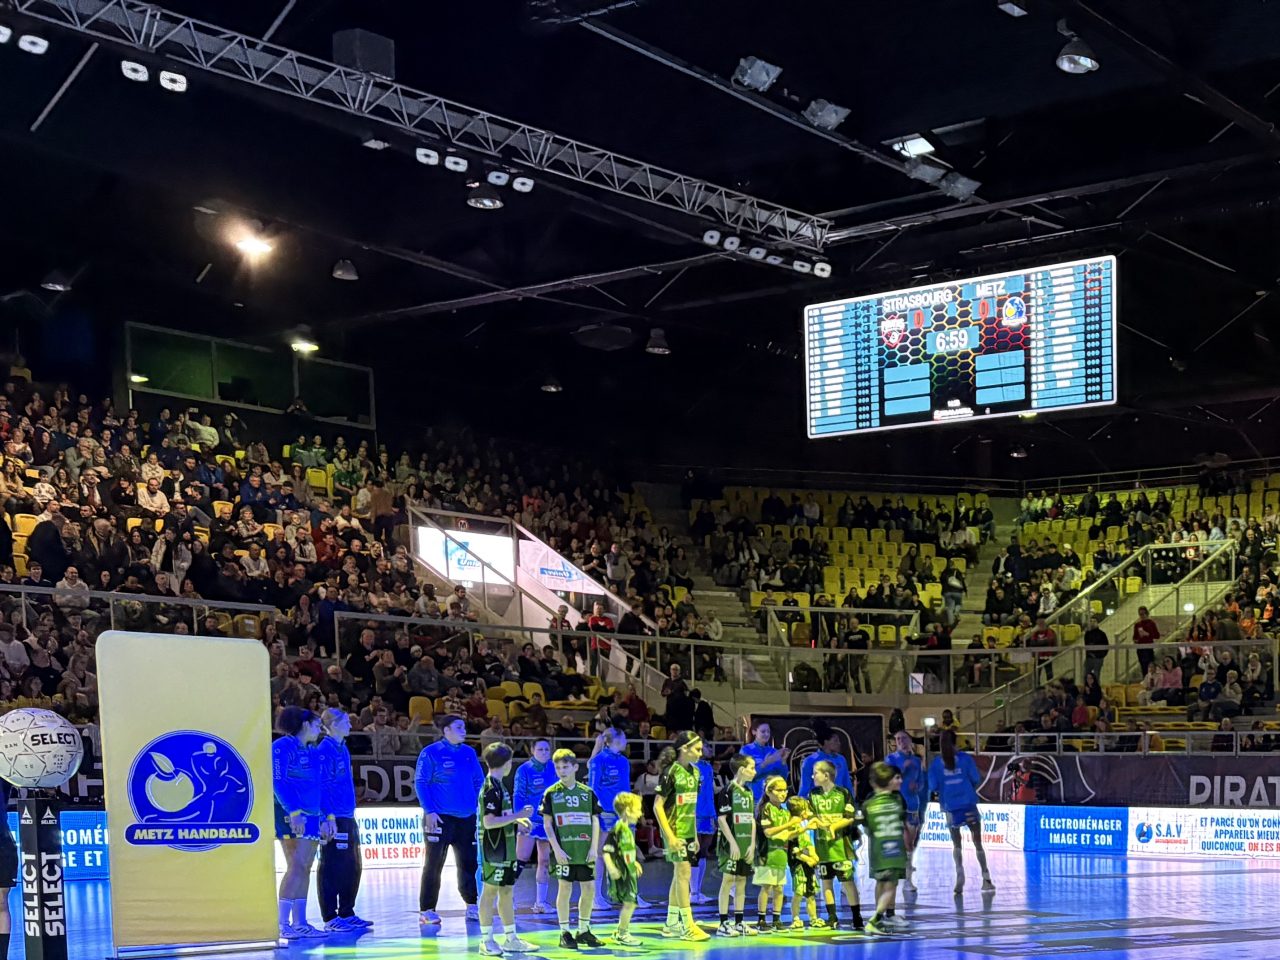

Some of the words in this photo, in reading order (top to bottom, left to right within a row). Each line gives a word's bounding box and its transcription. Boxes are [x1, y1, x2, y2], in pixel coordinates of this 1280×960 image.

[976, 281, 1006, 298] METZ
[882, 289, 952, 312] STRASBOURG
[979, 300, 989, 318] 0
[914, 310, 924, 328] 0
[936, 330, 968, 350] 6:59
[31, 733, 76, 746] SELECT
[565, 796, 580, 807] 39
[819, 799, 832, 810] 20
[1200, 817, 1208, 827] ET
[1210, 817, 1235, 828] PARCE
[1237, 818, 1260, 829] QU'ON
[134, 828, 175, 841] METZ
[177, 827, 252, 840] HANDBALL
[376, 833, 406, 845] MIEUX
[409, 832, 423, 845] QU
[1049, 832, 1078, 844] IMAGE
[1081, 834, 1091, 845] ET
[1094, 834, 1113, 846] SON
[1214, 829, 1255, 840] APPAREILS
[1257, 830, 1280, 840] MIEUX
[365, 848, 379, 859] ON
[382, 847, 399, 859] LES
[1248, 842, 1259, 852] ON
[1261, 843, 1274, 852] LES
[84, 851, 103, 867] ET
[555, 865, 570, 876] 39
[21, 852, 41, 937] SELECT
[41, 852, 65, 937] SELECT
